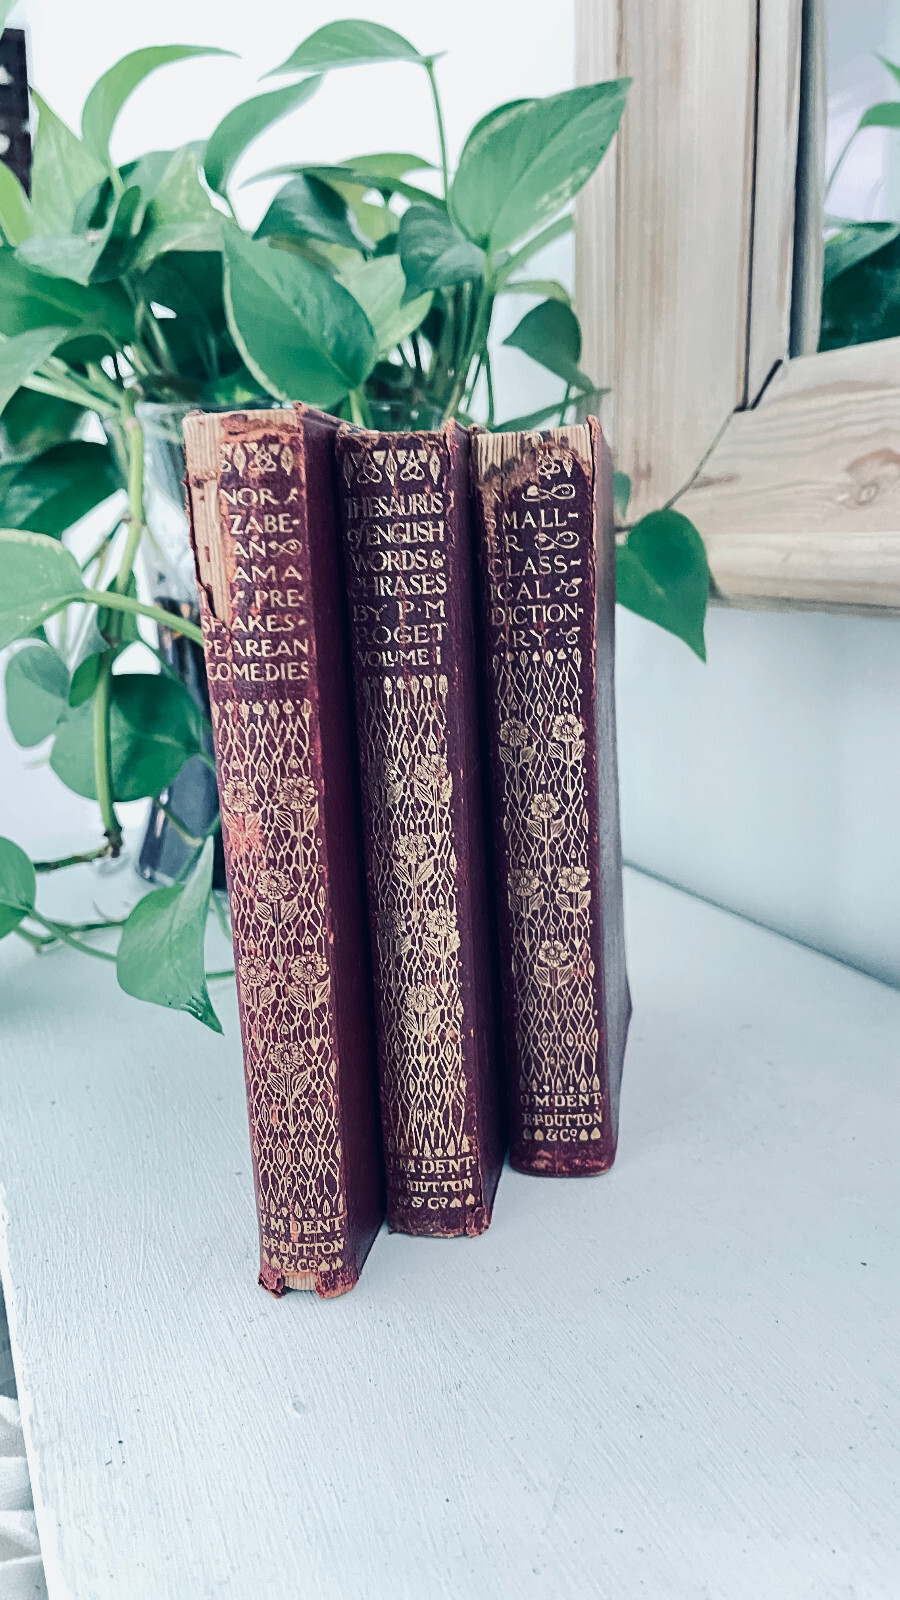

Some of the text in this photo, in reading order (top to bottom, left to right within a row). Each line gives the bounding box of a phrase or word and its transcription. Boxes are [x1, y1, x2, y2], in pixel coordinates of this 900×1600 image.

[344, 492, 444, 519] THESAURUS
[350, 549, 429, 572] WORDS
[354, 621, 449, 645] ROGET
[493, 628, 550, 648] ARY
[356, 648, 430, 668] VOLUME
[206, 660, 311, 682] COMEDIES
